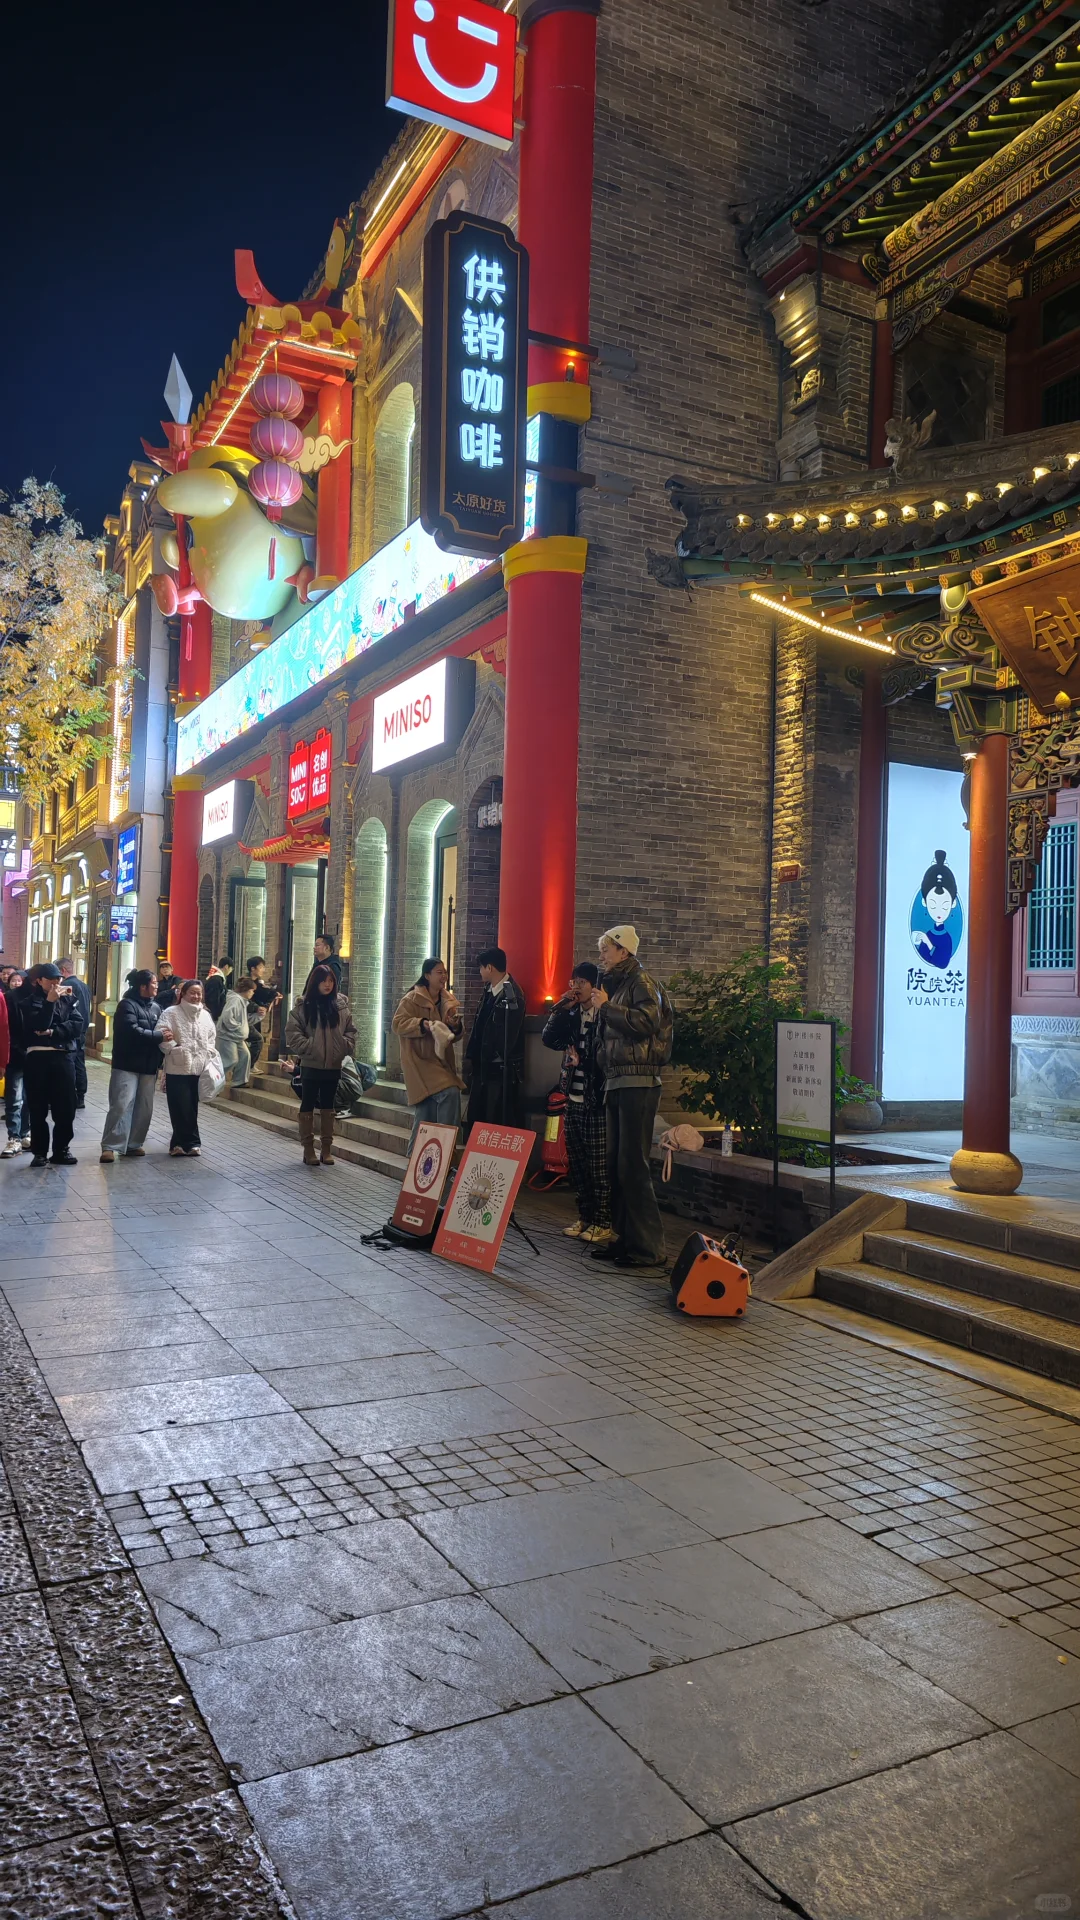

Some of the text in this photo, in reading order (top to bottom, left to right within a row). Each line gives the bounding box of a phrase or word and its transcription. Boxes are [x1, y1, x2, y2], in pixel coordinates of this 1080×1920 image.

[459, 254, 506, 469] 供销咖啡
[452, 491, 506, 514] 太原好货
[384, 694, 432, 743] MINISO
[291, 761, 306, 783] MINI
[313, 749, 328, 774] 名创
[312, 774, 327, 797] 优品
[208, 801, 228, 827] MINISO
[478, 802, 503, 828] 供销
[906, 968, 965, 994] 院院茶
[906, 996, 964, 1007] YUANTEA
[476, 1129, 526, 1153] 微信点歌
